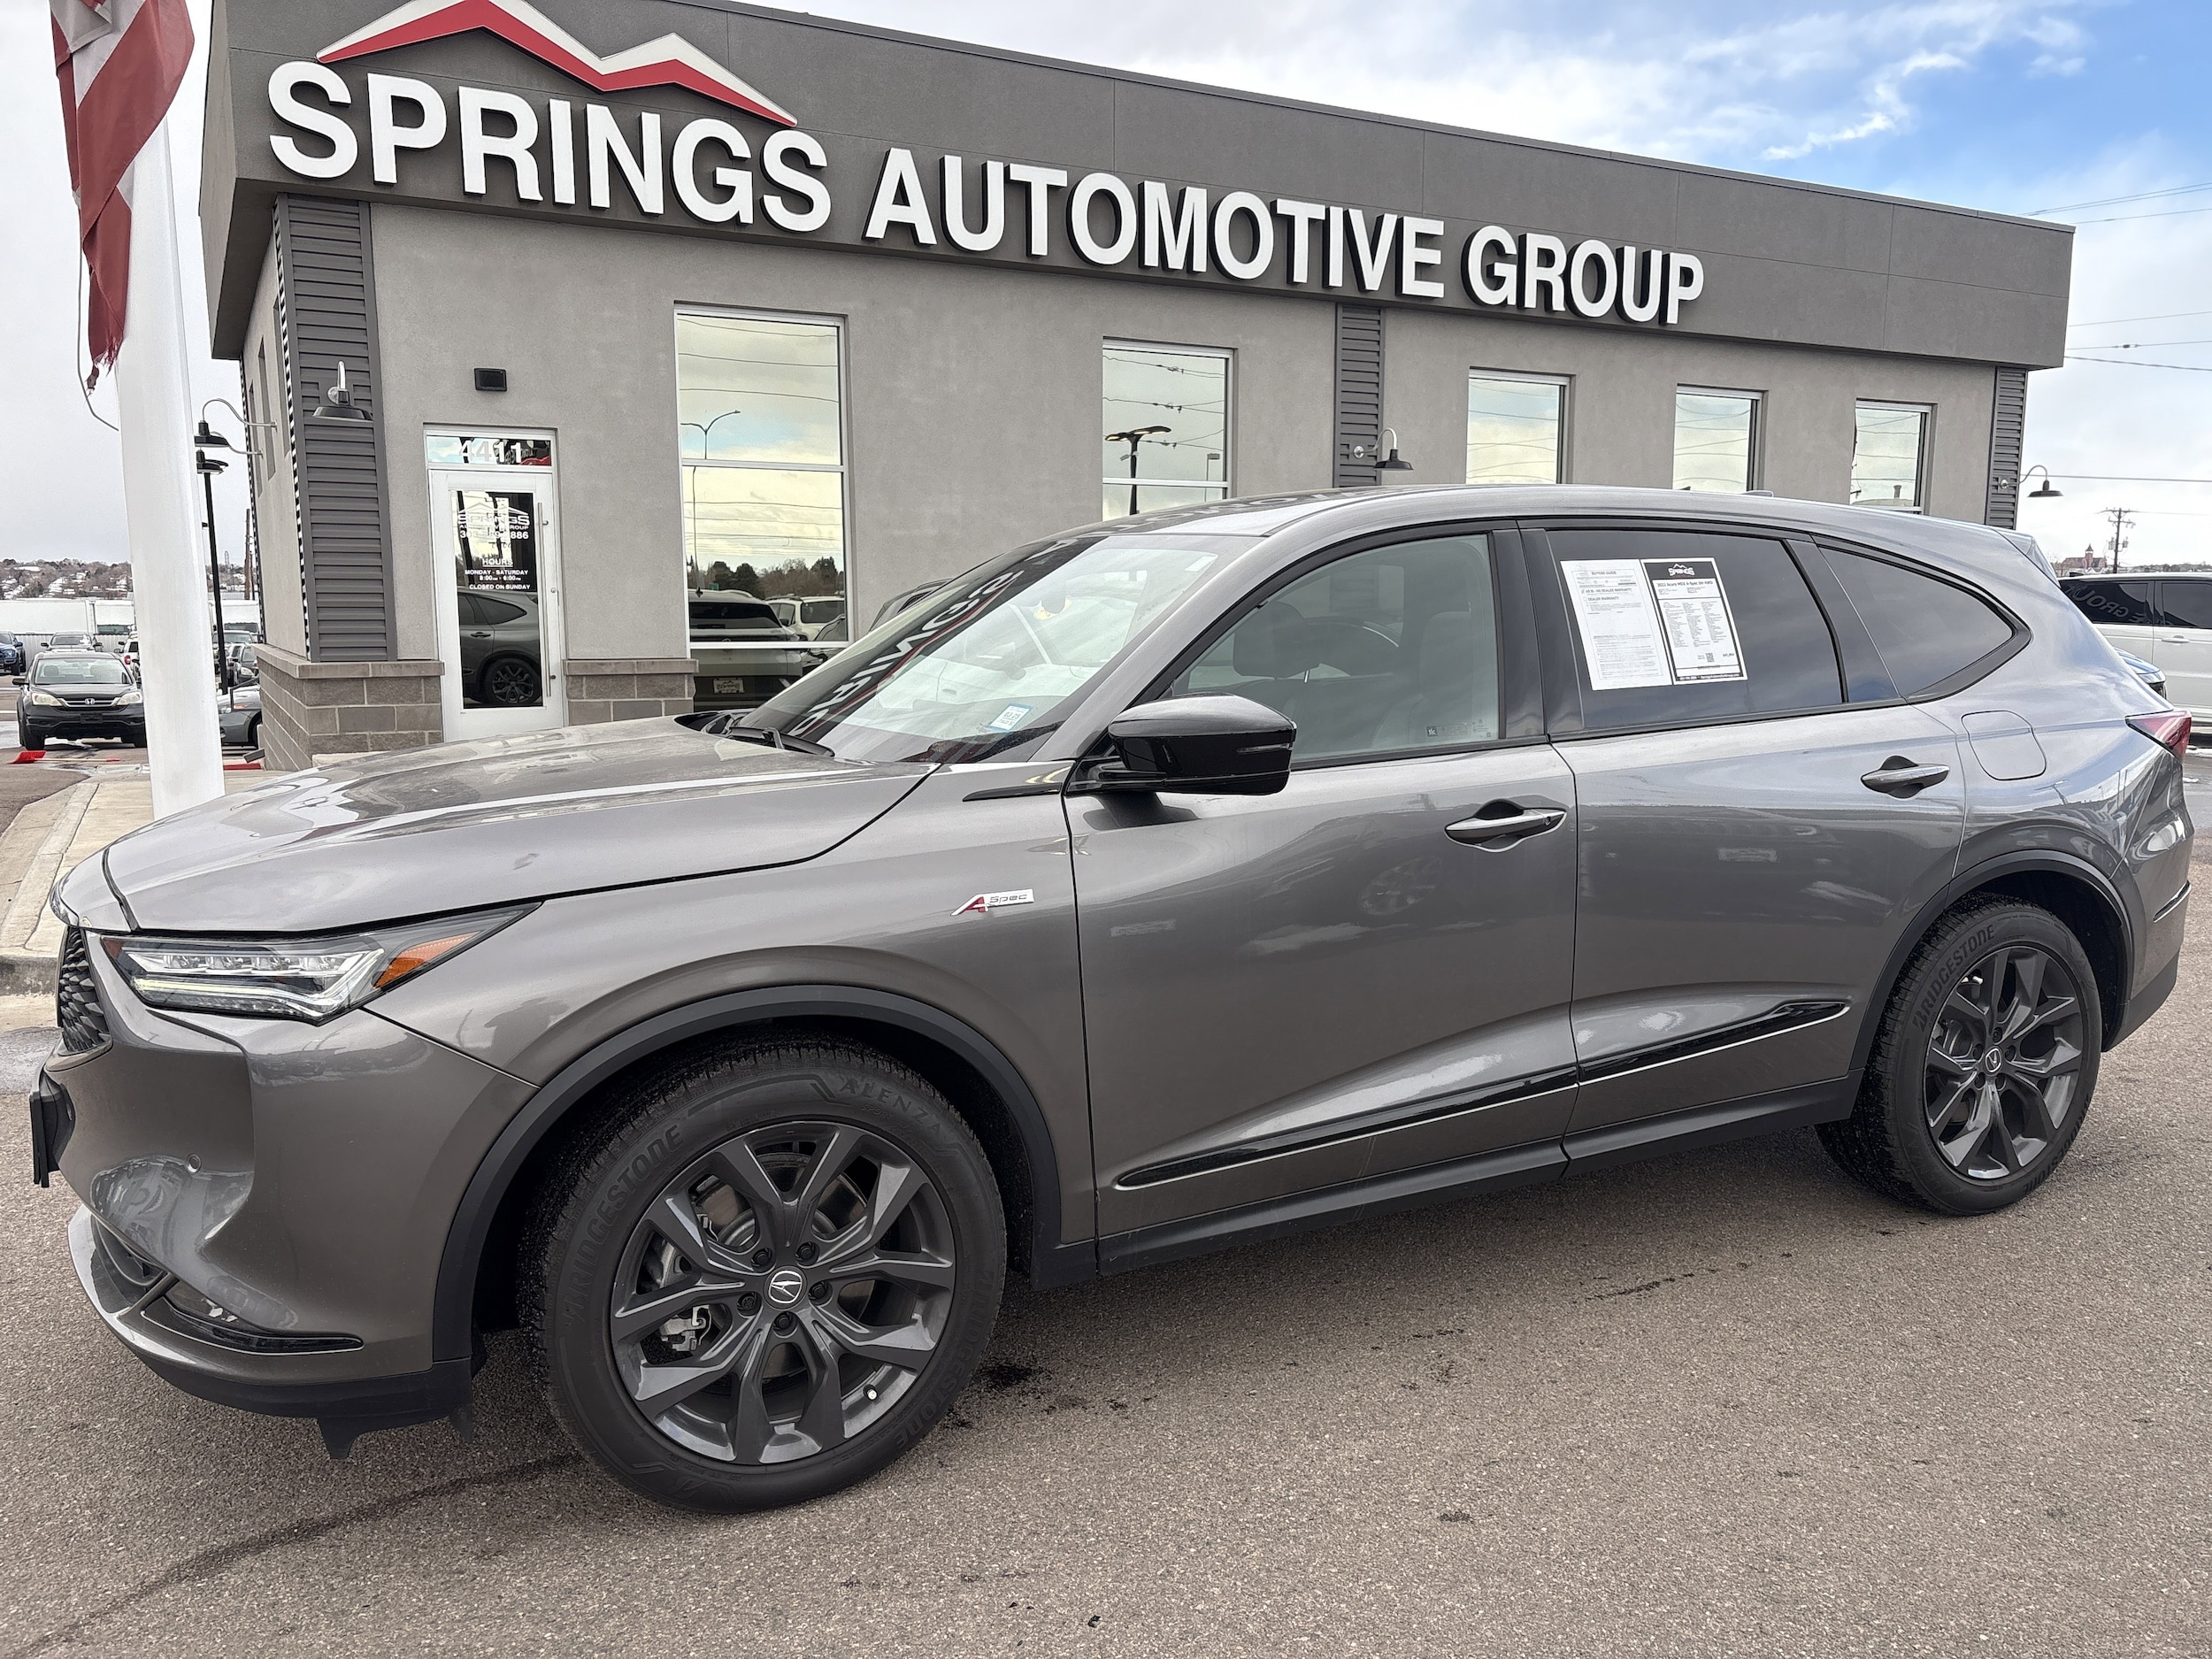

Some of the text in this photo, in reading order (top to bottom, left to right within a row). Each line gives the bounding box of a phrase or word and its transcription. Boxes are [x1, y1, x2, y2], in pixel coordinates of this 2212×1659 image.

[268, 61, 1705, 325] SPRINGS AUTOMOTIVE GROUP
[460, 440, 523, 464] 4411
[1913, 925, 1995, 1033] BRIDGESTONE
[840, 1077, 942, 1139] ALENZA
[562, 1124, 683, 1322] BRIDGESTONE
